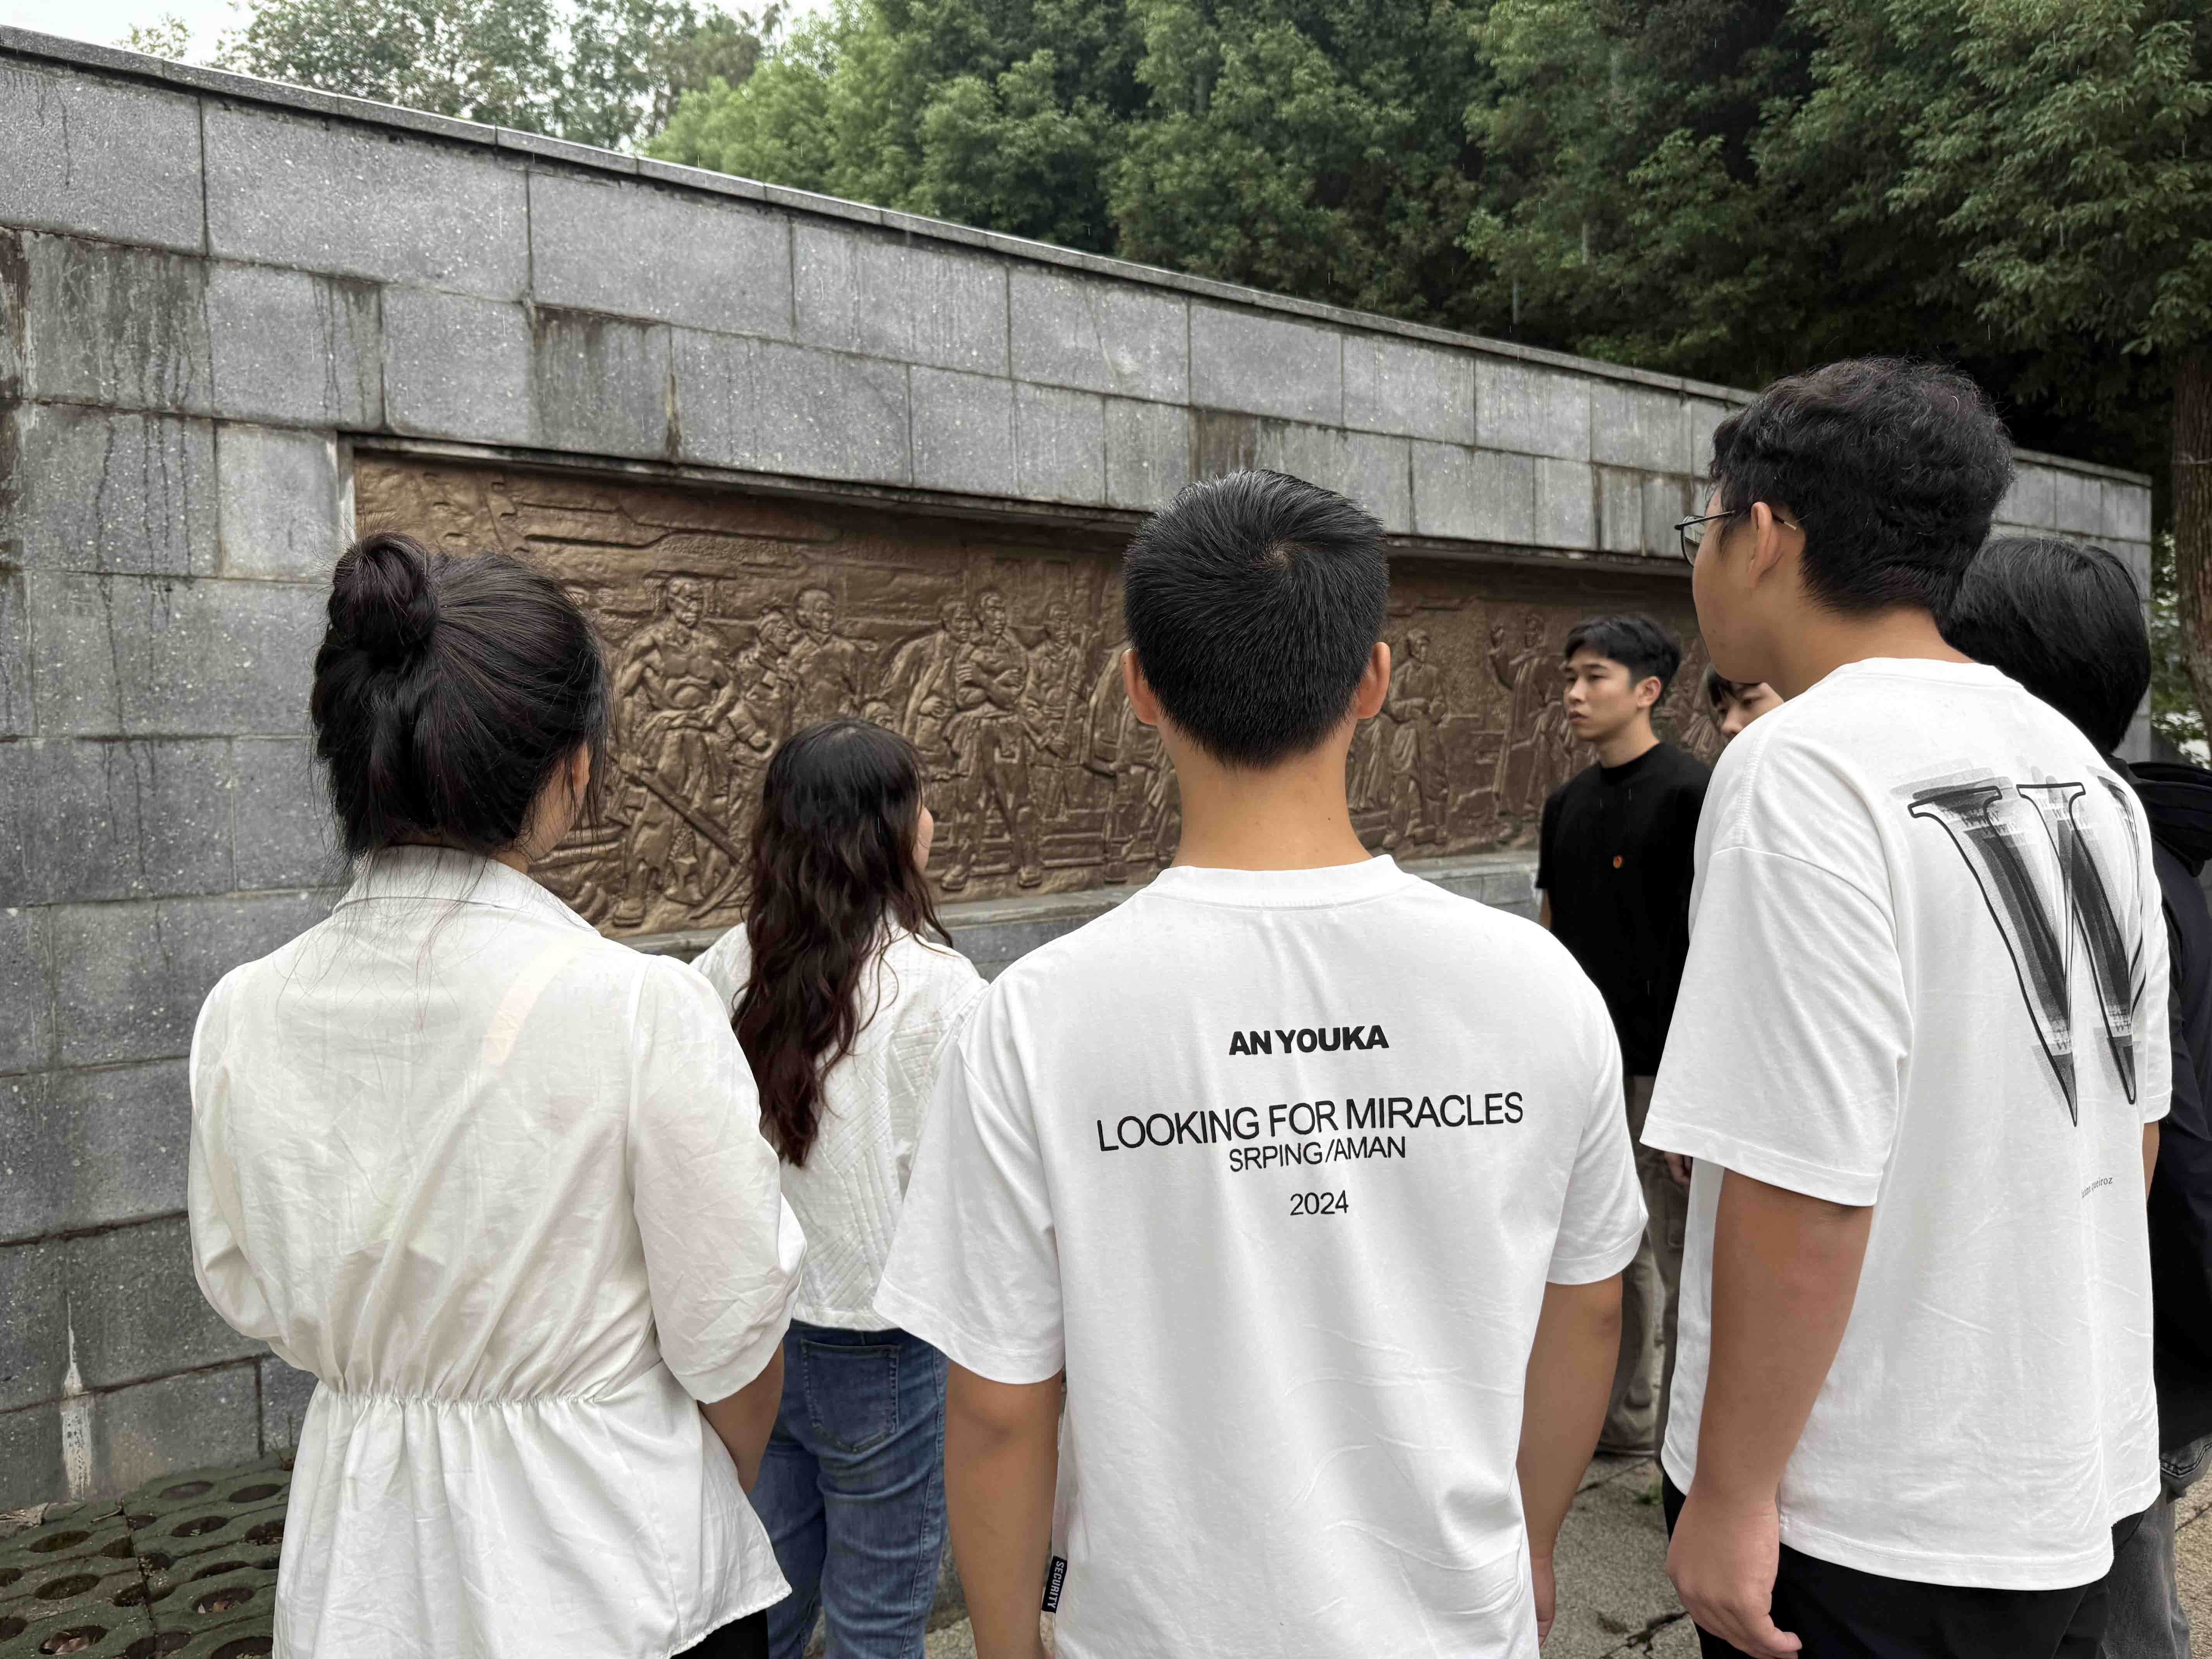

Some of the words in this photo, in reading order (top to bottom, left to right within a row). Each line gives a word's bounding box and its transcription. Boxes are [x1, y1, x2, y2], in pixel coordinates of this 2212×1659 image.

[1097, 1107, 1259, 1152] LOOKING
[1269, 1101, 1339, 1137] FOR
[1346, 1092, 1523, 1129] MIRACLES
[1230, 1136, 1406, 1172] SRPING/AMAN
[1290, 1190, 1349, 1216] 2024
[1047, 1561, 1065, 1609] SECURITY
